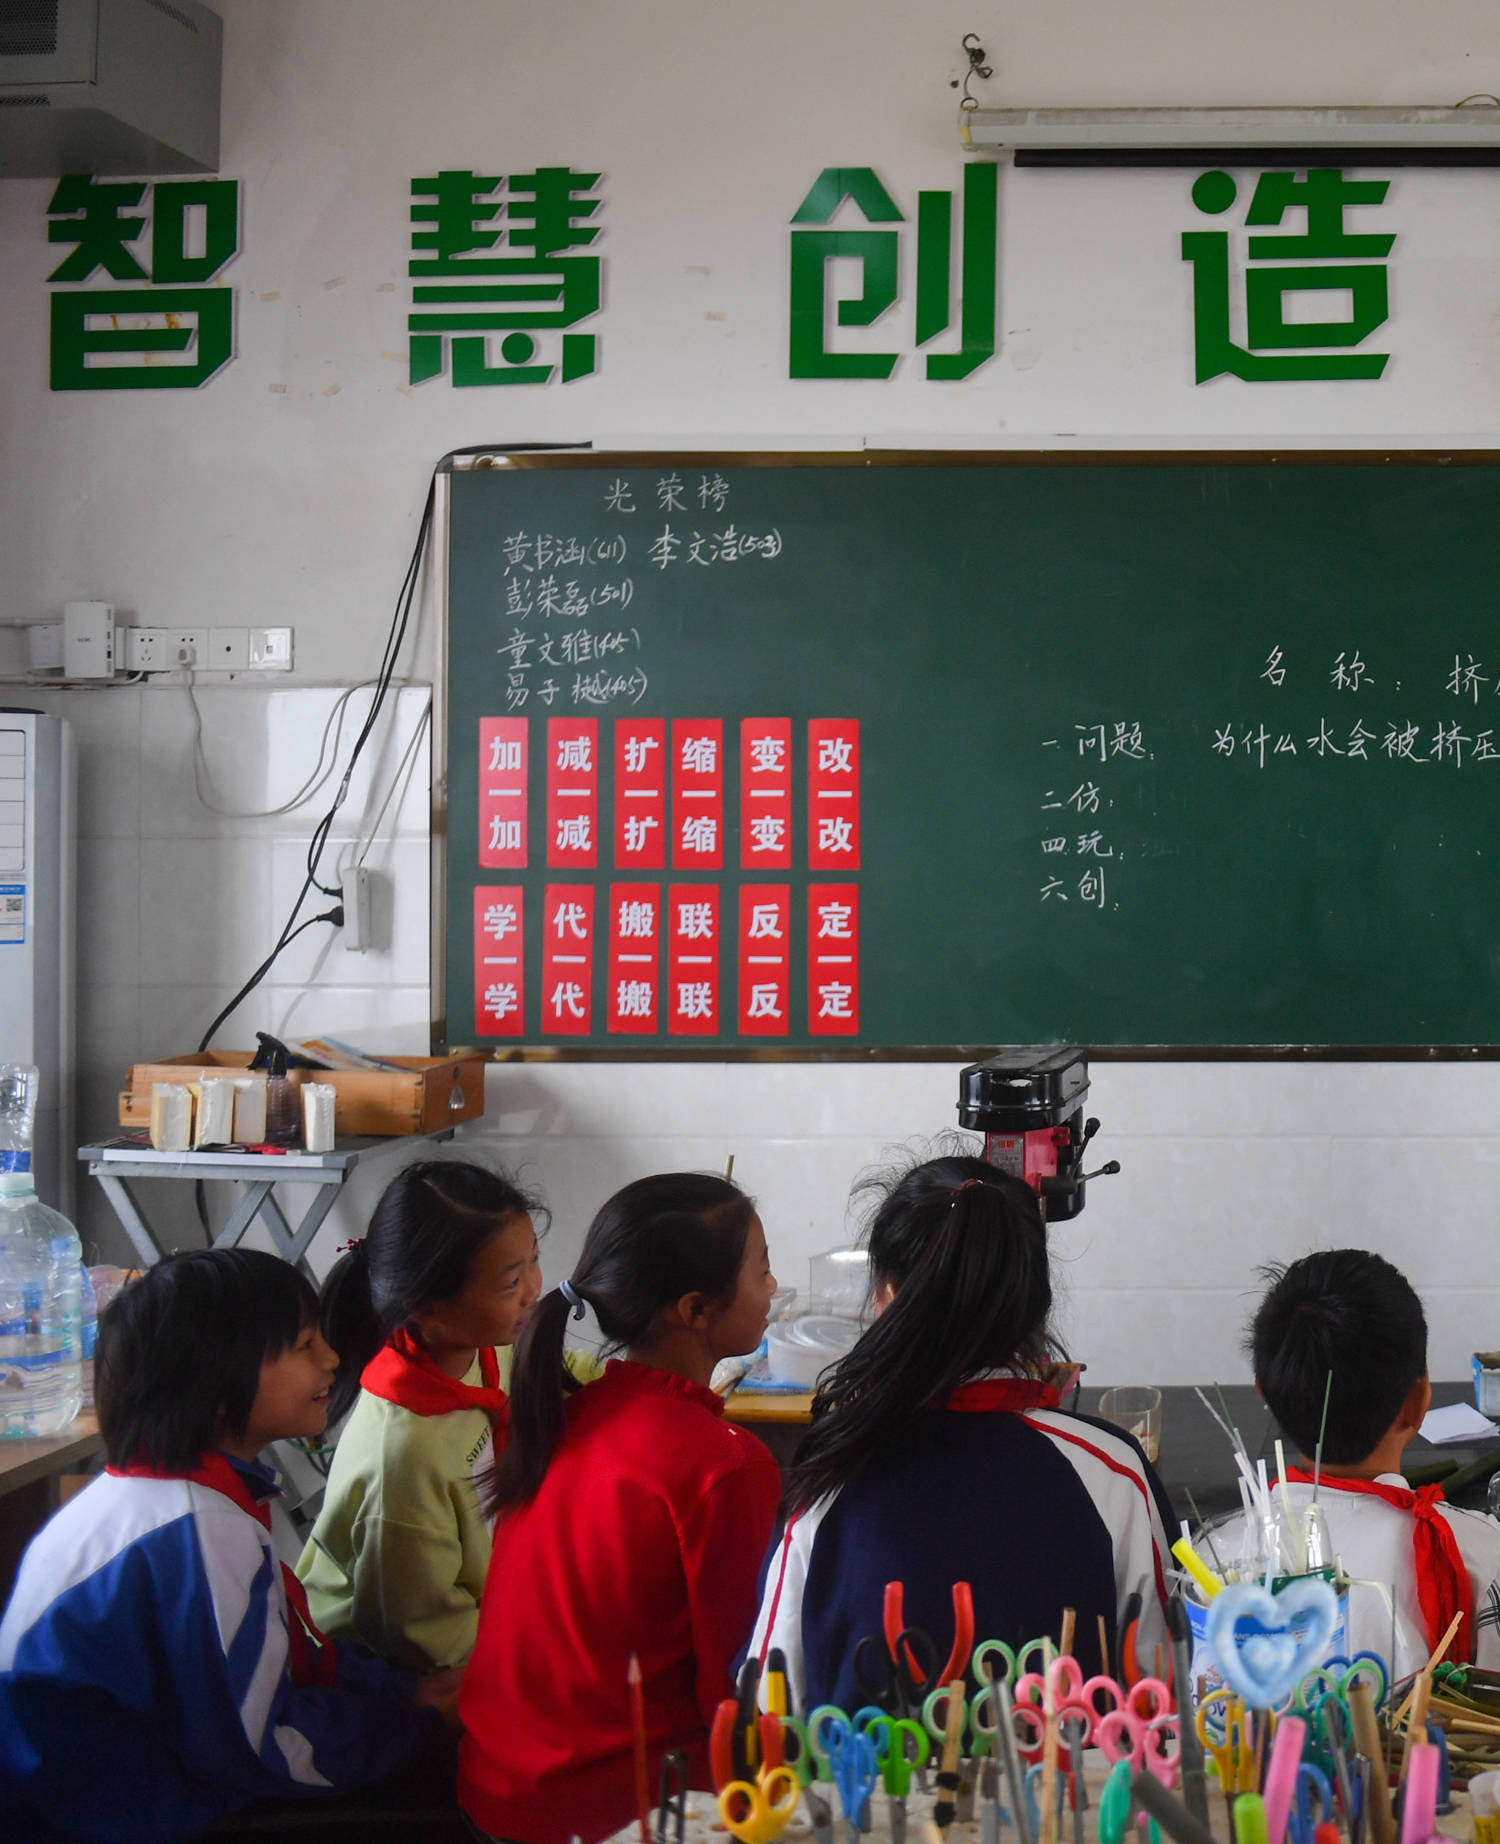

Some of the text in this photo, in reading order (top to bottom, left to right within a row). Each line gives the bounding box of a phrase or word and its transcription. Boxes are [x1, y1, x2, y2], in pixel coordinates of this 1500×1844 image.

[603, 472, 731, 513] 光荣榜
[488, 735, 522, 851] 加一加
[557, 735, 593, 851] 减一减
[624, 736, 659, 851] 扩一扩
[681, 737, 717, 852] 缩一缩
[750, 735, 785, 852] 变一变
[817, 737, 853, 853] 改一改
[484, 903, 518, 1019] 学一学
[551, 903, 587, 1018] 代一代
[617, 901, 654, 1017] 搬一搬
[677, 903, 713, 1018] 联一联
[748, 903, 783, 1018] 反一反
[817, 901, 852, 1017] 定一定
[465, 1424, 490, 1464] SWEET
